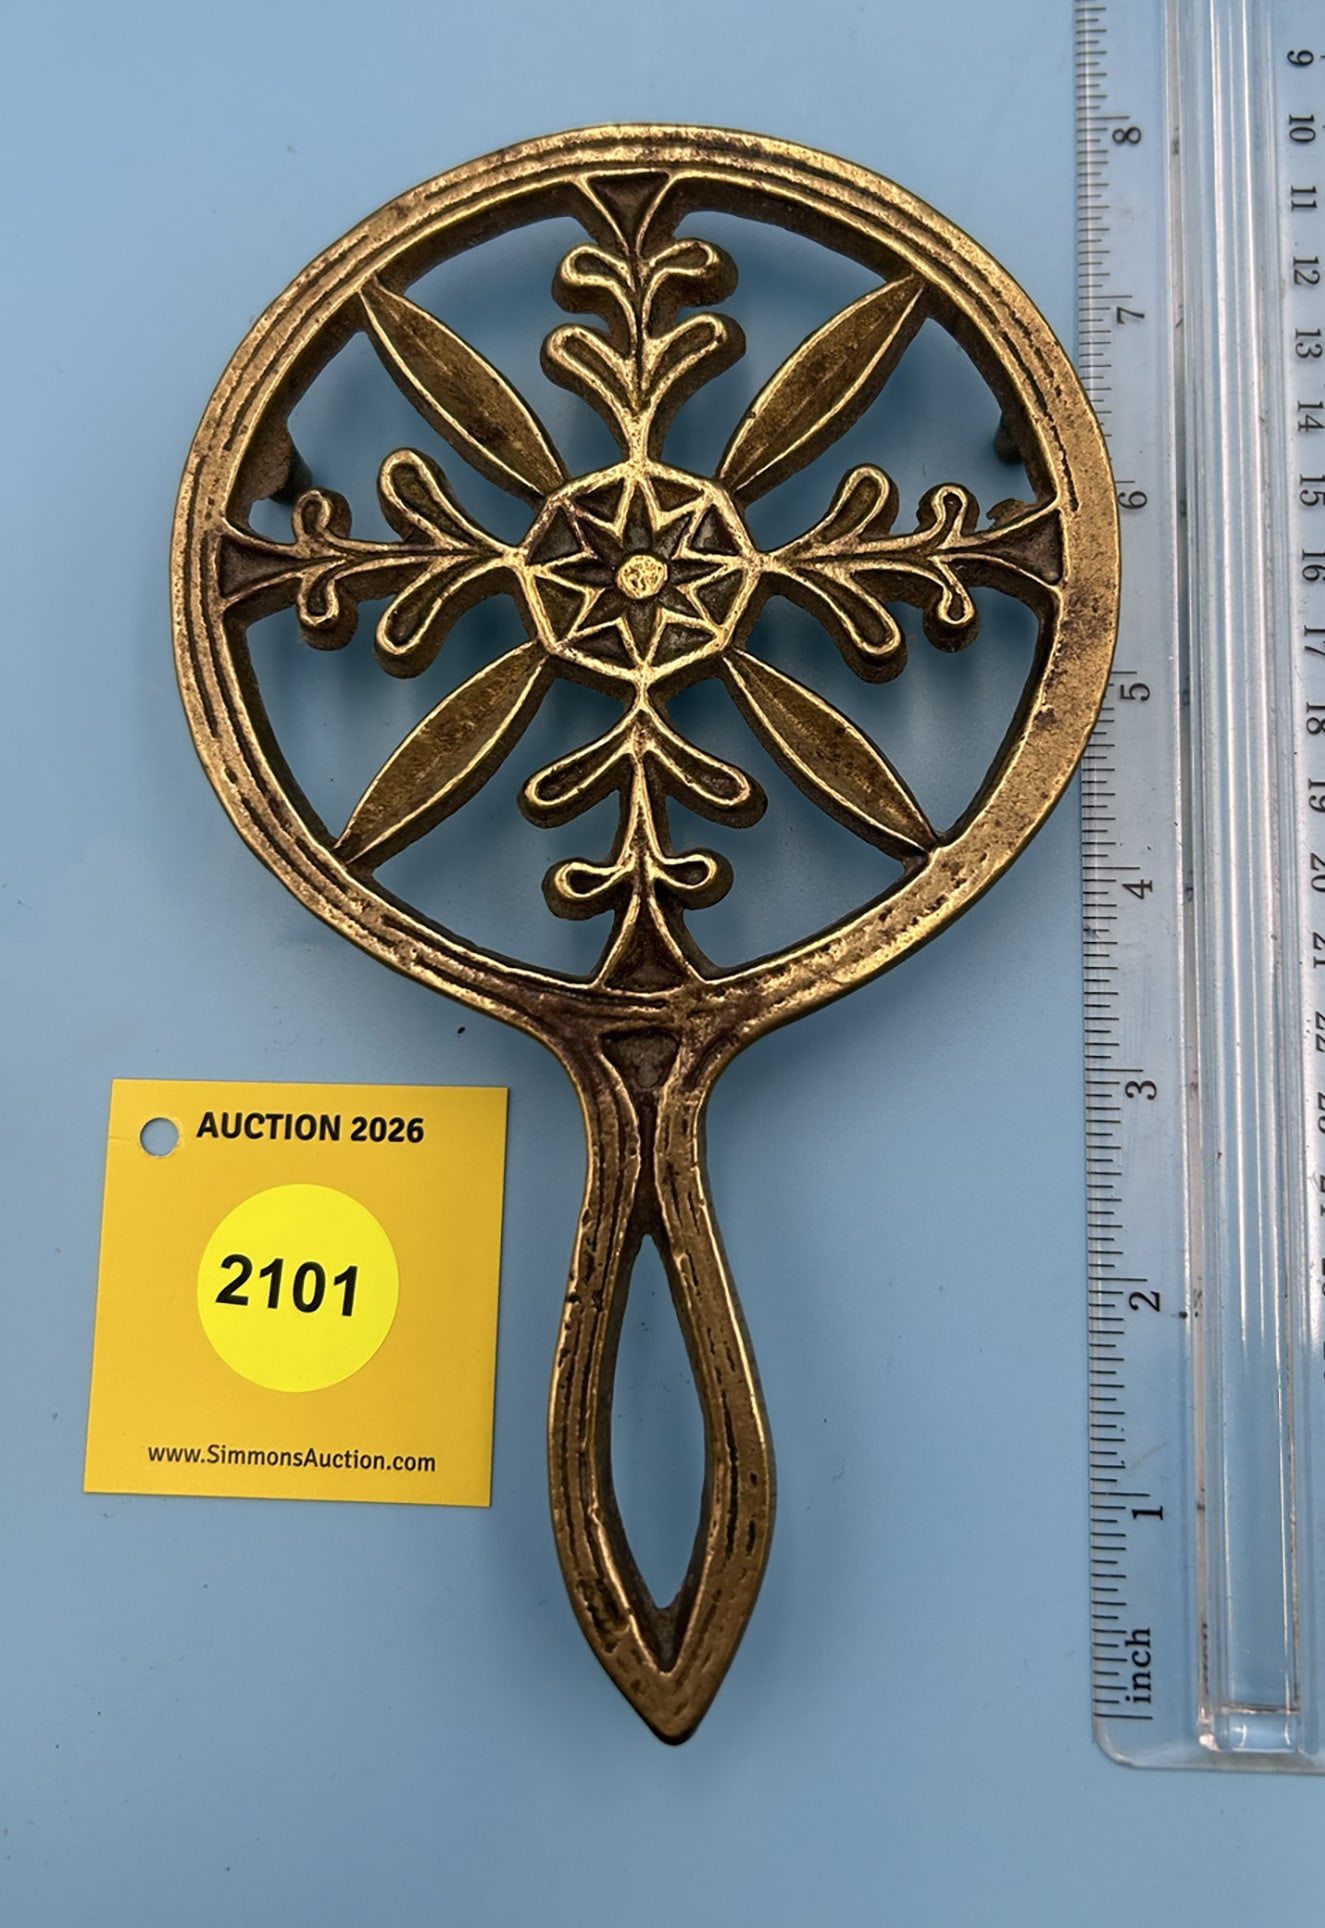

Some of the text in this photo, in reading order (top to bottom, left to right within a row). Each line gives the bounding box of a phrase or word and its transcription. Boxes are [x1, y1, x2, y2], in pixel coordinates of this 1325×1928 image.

[1287, 49, 1314, 67] 9
[1112, 126, 1141, 145] 8
[1288, 114, 1316, 144] 10
[1290, 185, 1318, 212] 11
[1293, 256, 1320, 286] 12
[1116, 306, 1145, 325] 7
[1295, 328, 1323, 359] 13
[1297, 400, 1325, 433] 14
[1119, 490, 1148, 510] 6
[1299, 473, 1325, 507] 15
[1301, 549, 1325, 582] 16
[1304, 625, 1325, 657] 17
[1120, 682, 1150, 702] 5
[1305, 702, 1325, 736] 18
[1122, 879, 1153, 900] 4
[1125, 1079, 1158, 1101] 3
[196, 1111, 425, 1143] AUCTION 2026
[215, 1254, 359, 1317] 2101
[1128, 1290, 1160, 1312] 2
[148, 1444, 436, 1472] www.SimmonsAuction.com
[1131, 1504, 1164, 1521] 1
[1125, 1627, 1151, 1705] inch
